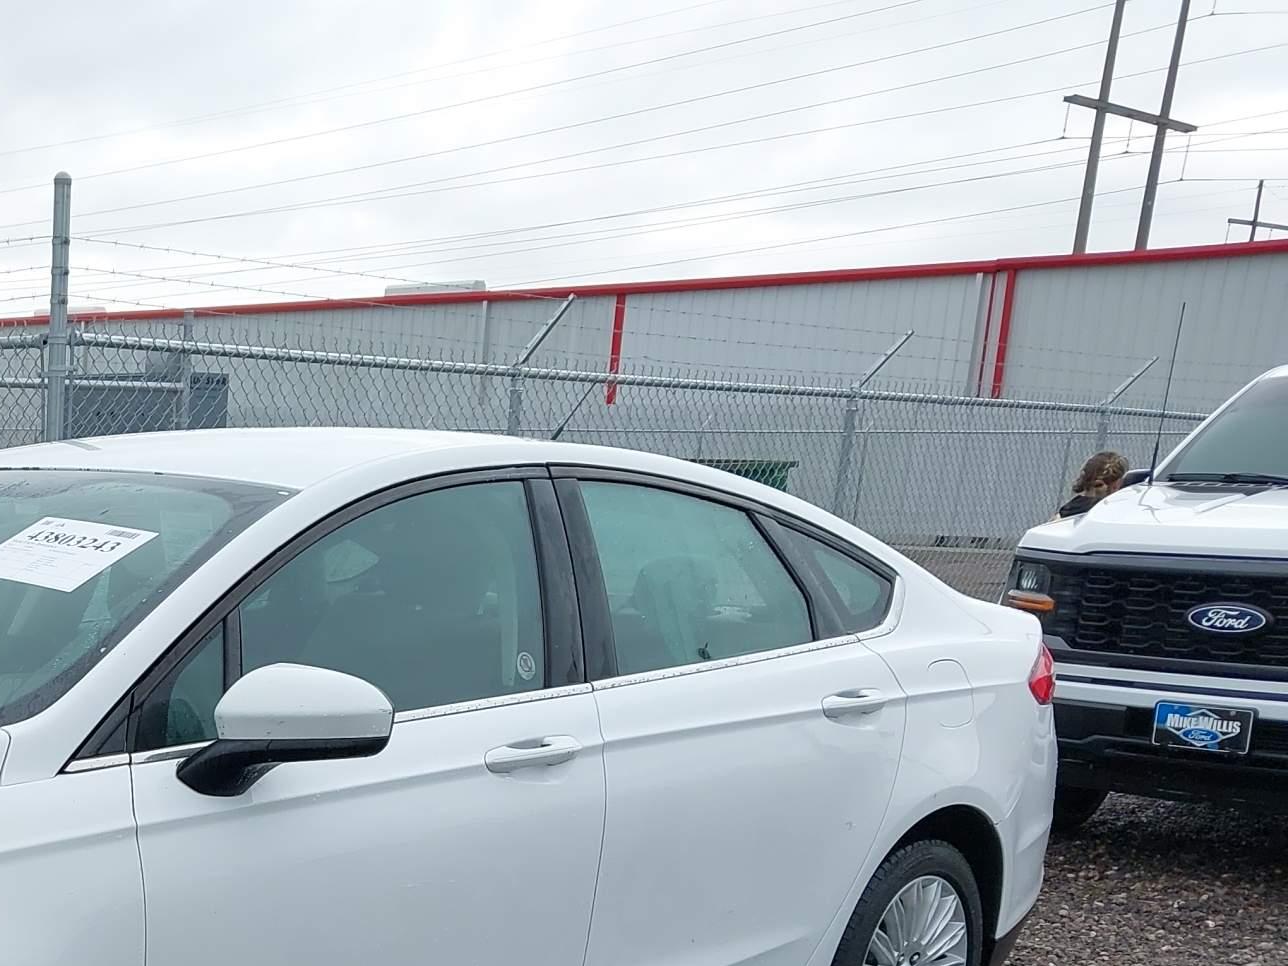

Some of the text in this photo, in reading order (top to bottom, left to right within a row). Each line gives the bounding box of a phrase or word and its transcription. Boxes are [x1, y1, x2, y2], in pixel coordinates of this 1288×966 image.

[27, 529, 122, 553] 43803243
[1202, 608, 1251, 629] Ford
[1187, 729, 1213, 741] Ford
